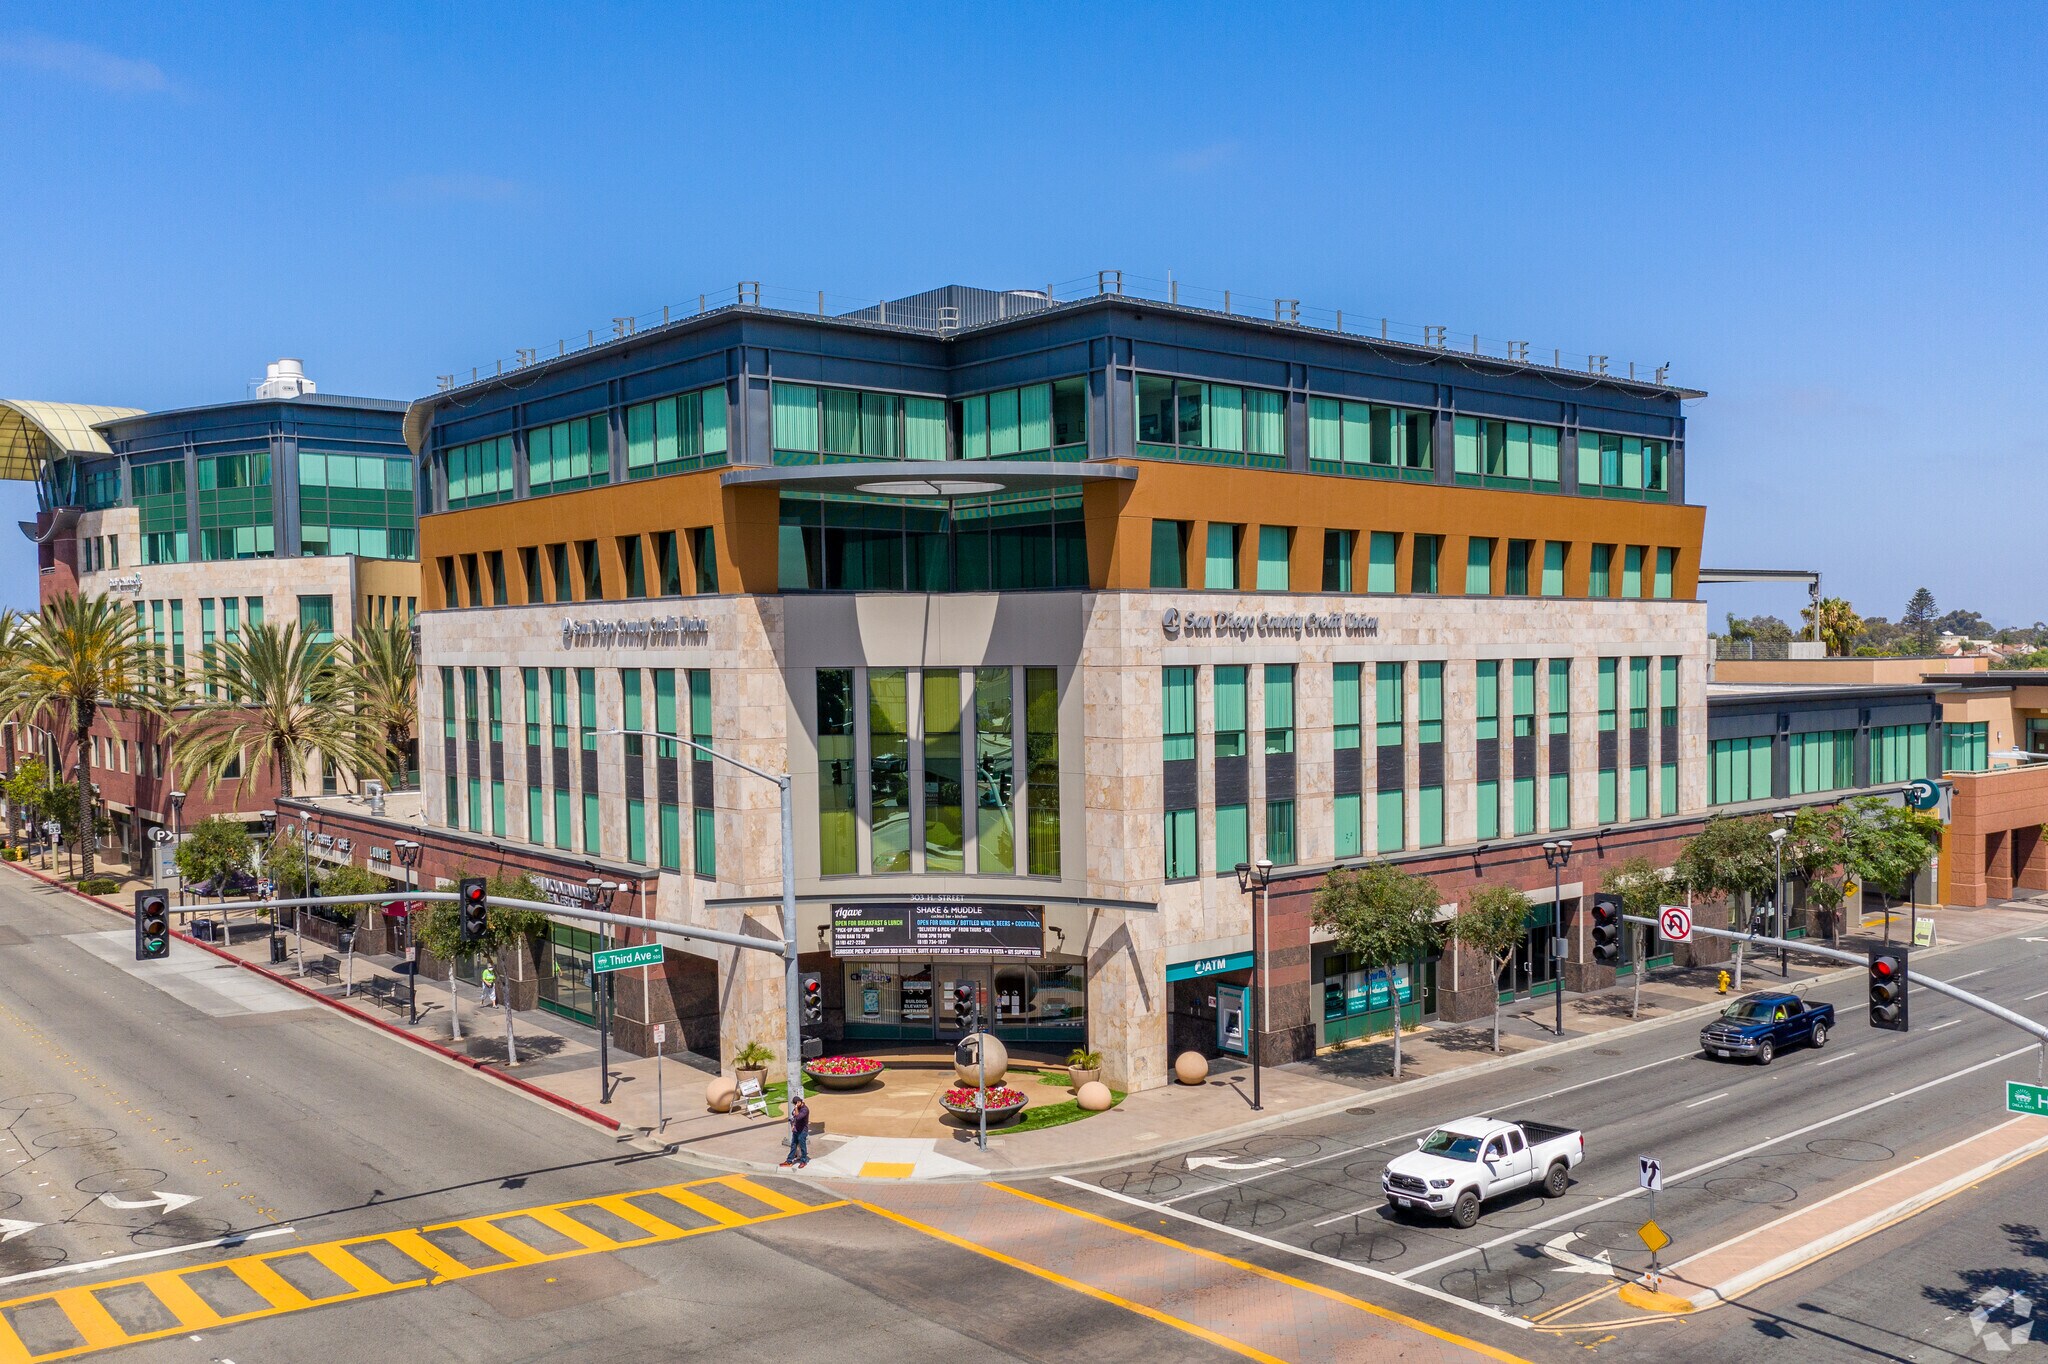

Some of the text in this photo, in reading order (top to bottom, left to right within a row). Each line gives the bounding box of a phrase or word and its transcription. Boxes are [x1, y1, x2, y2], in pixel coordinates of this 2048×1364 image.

[574, 614, 709, 638] San Diego County Credit Union
[1185, 611, 1379, 632] San Diego County Credit Union
[1912, 783, 1932, 805] P
[157, 830, 166, 840] P
[370, 846, 391, 860] LOUNGE
[835, 907, 862, 919] Agave
[916, 906, 942, 914] SHAKE
[610, 953, 633, 965] Third
[634, 952, 652, 962] Ave
[1205, 958, 1226, 972] ATM
[1379, 969, 1396, 979] Ras
[2037, 1093, 2048, 1109] H
